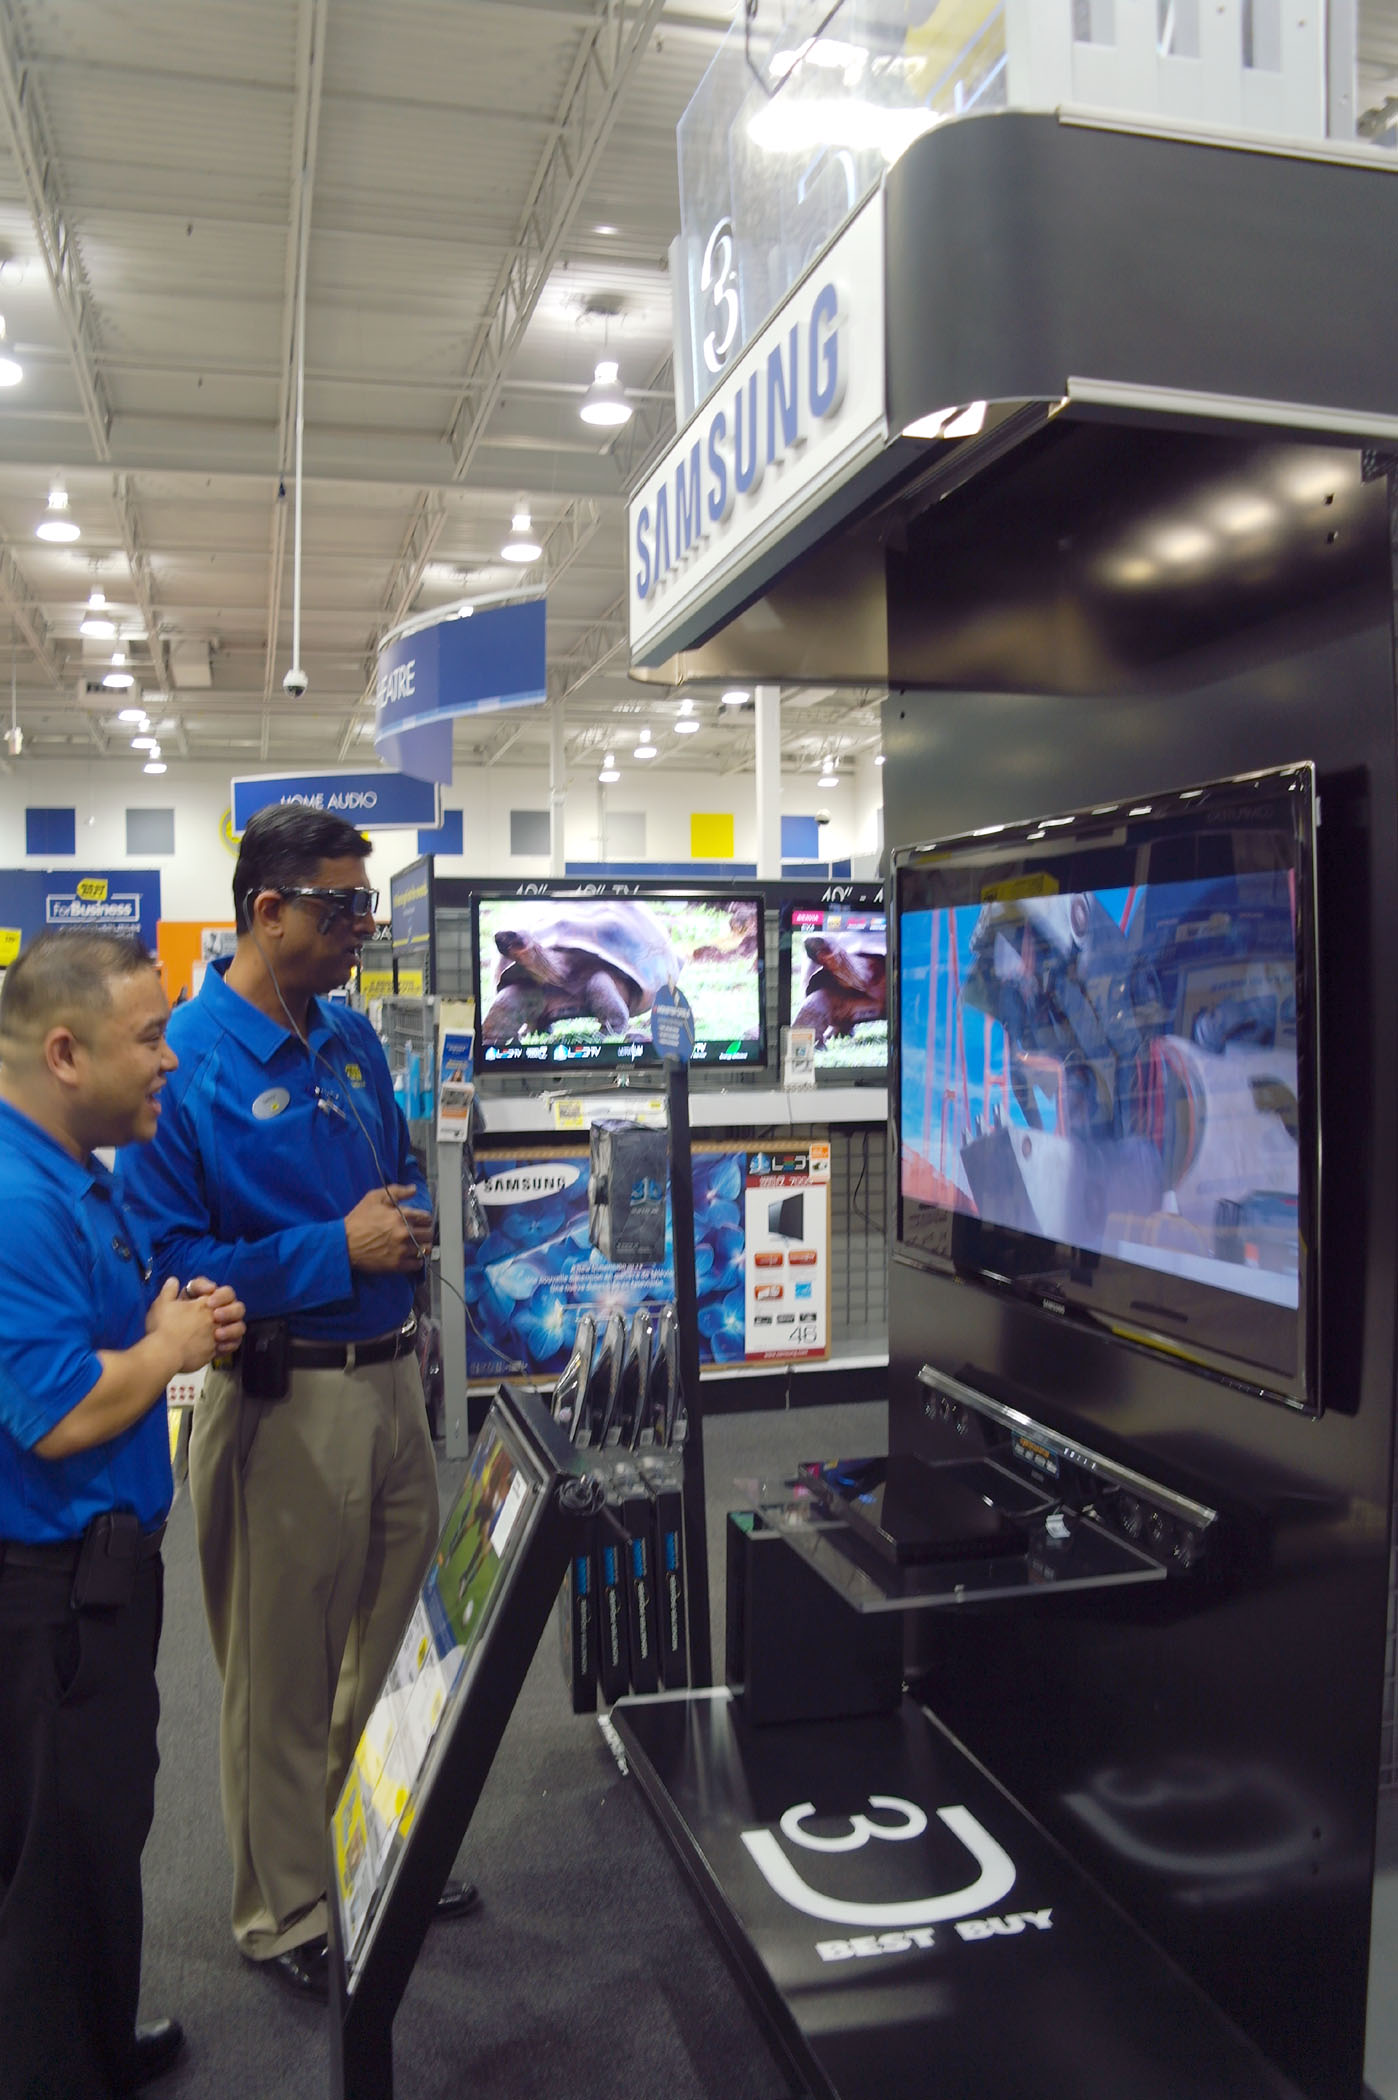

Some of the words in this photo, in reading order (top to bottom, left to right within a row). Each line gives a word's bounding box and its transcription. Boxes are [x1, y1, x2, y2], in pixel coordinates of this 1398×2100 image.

[637, 283, 838, 599] SAMSUNG
[327, 791, 378, 810] AUDIO
[484, 1177, 565, 1192] SAMSUNG
[815, 1927, 935, 1961] BEST
[954, 1908, 1053, 1941] BUY
